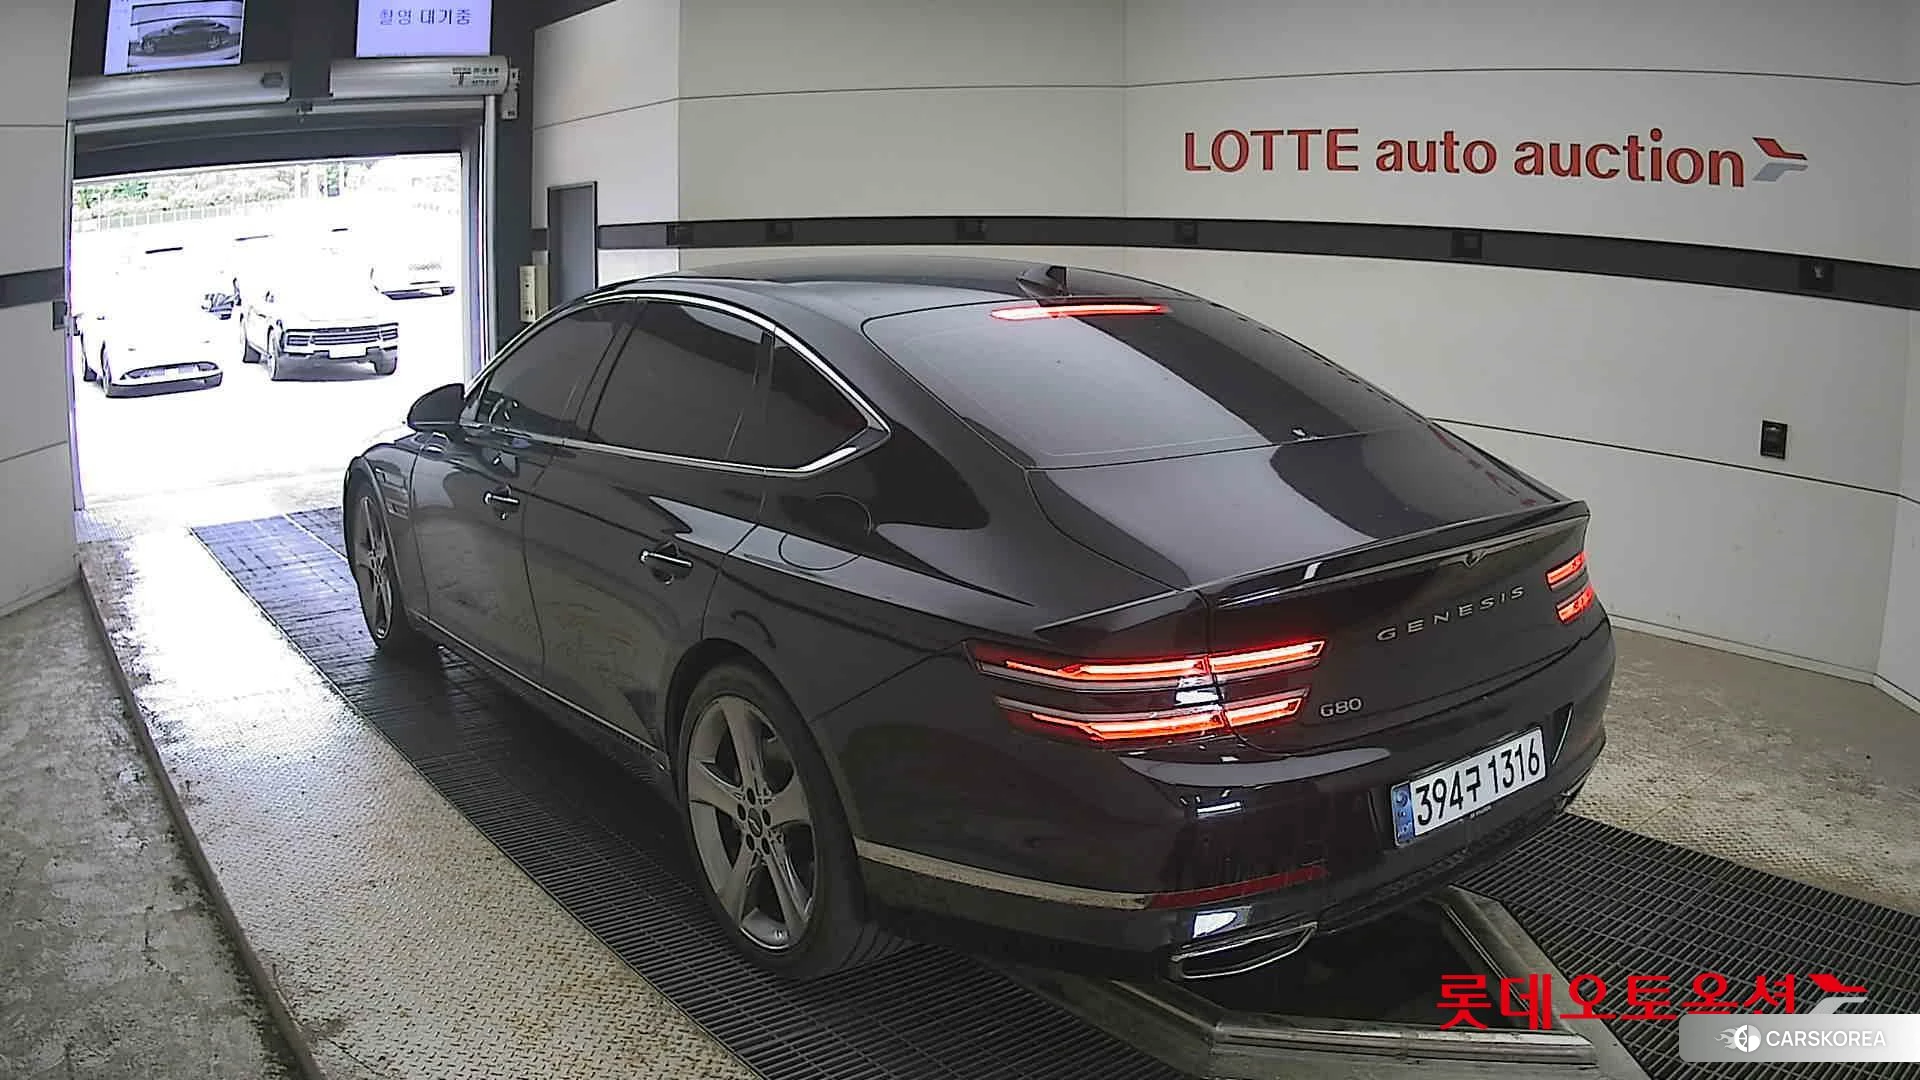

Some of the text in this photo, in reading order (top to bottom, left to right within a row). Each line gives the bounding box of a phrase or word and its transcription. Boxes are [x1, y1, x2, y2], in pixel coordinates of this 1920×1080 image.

[420, 8, 472, 25] 대기중
[1184, 128, 1745, 188] LOTTE auto auction
[1376, 586, 1525, 642] GENESIS
[1319, 697, 1363, 718] G80
[1415, 737, 1541, 826] 394구 1316
